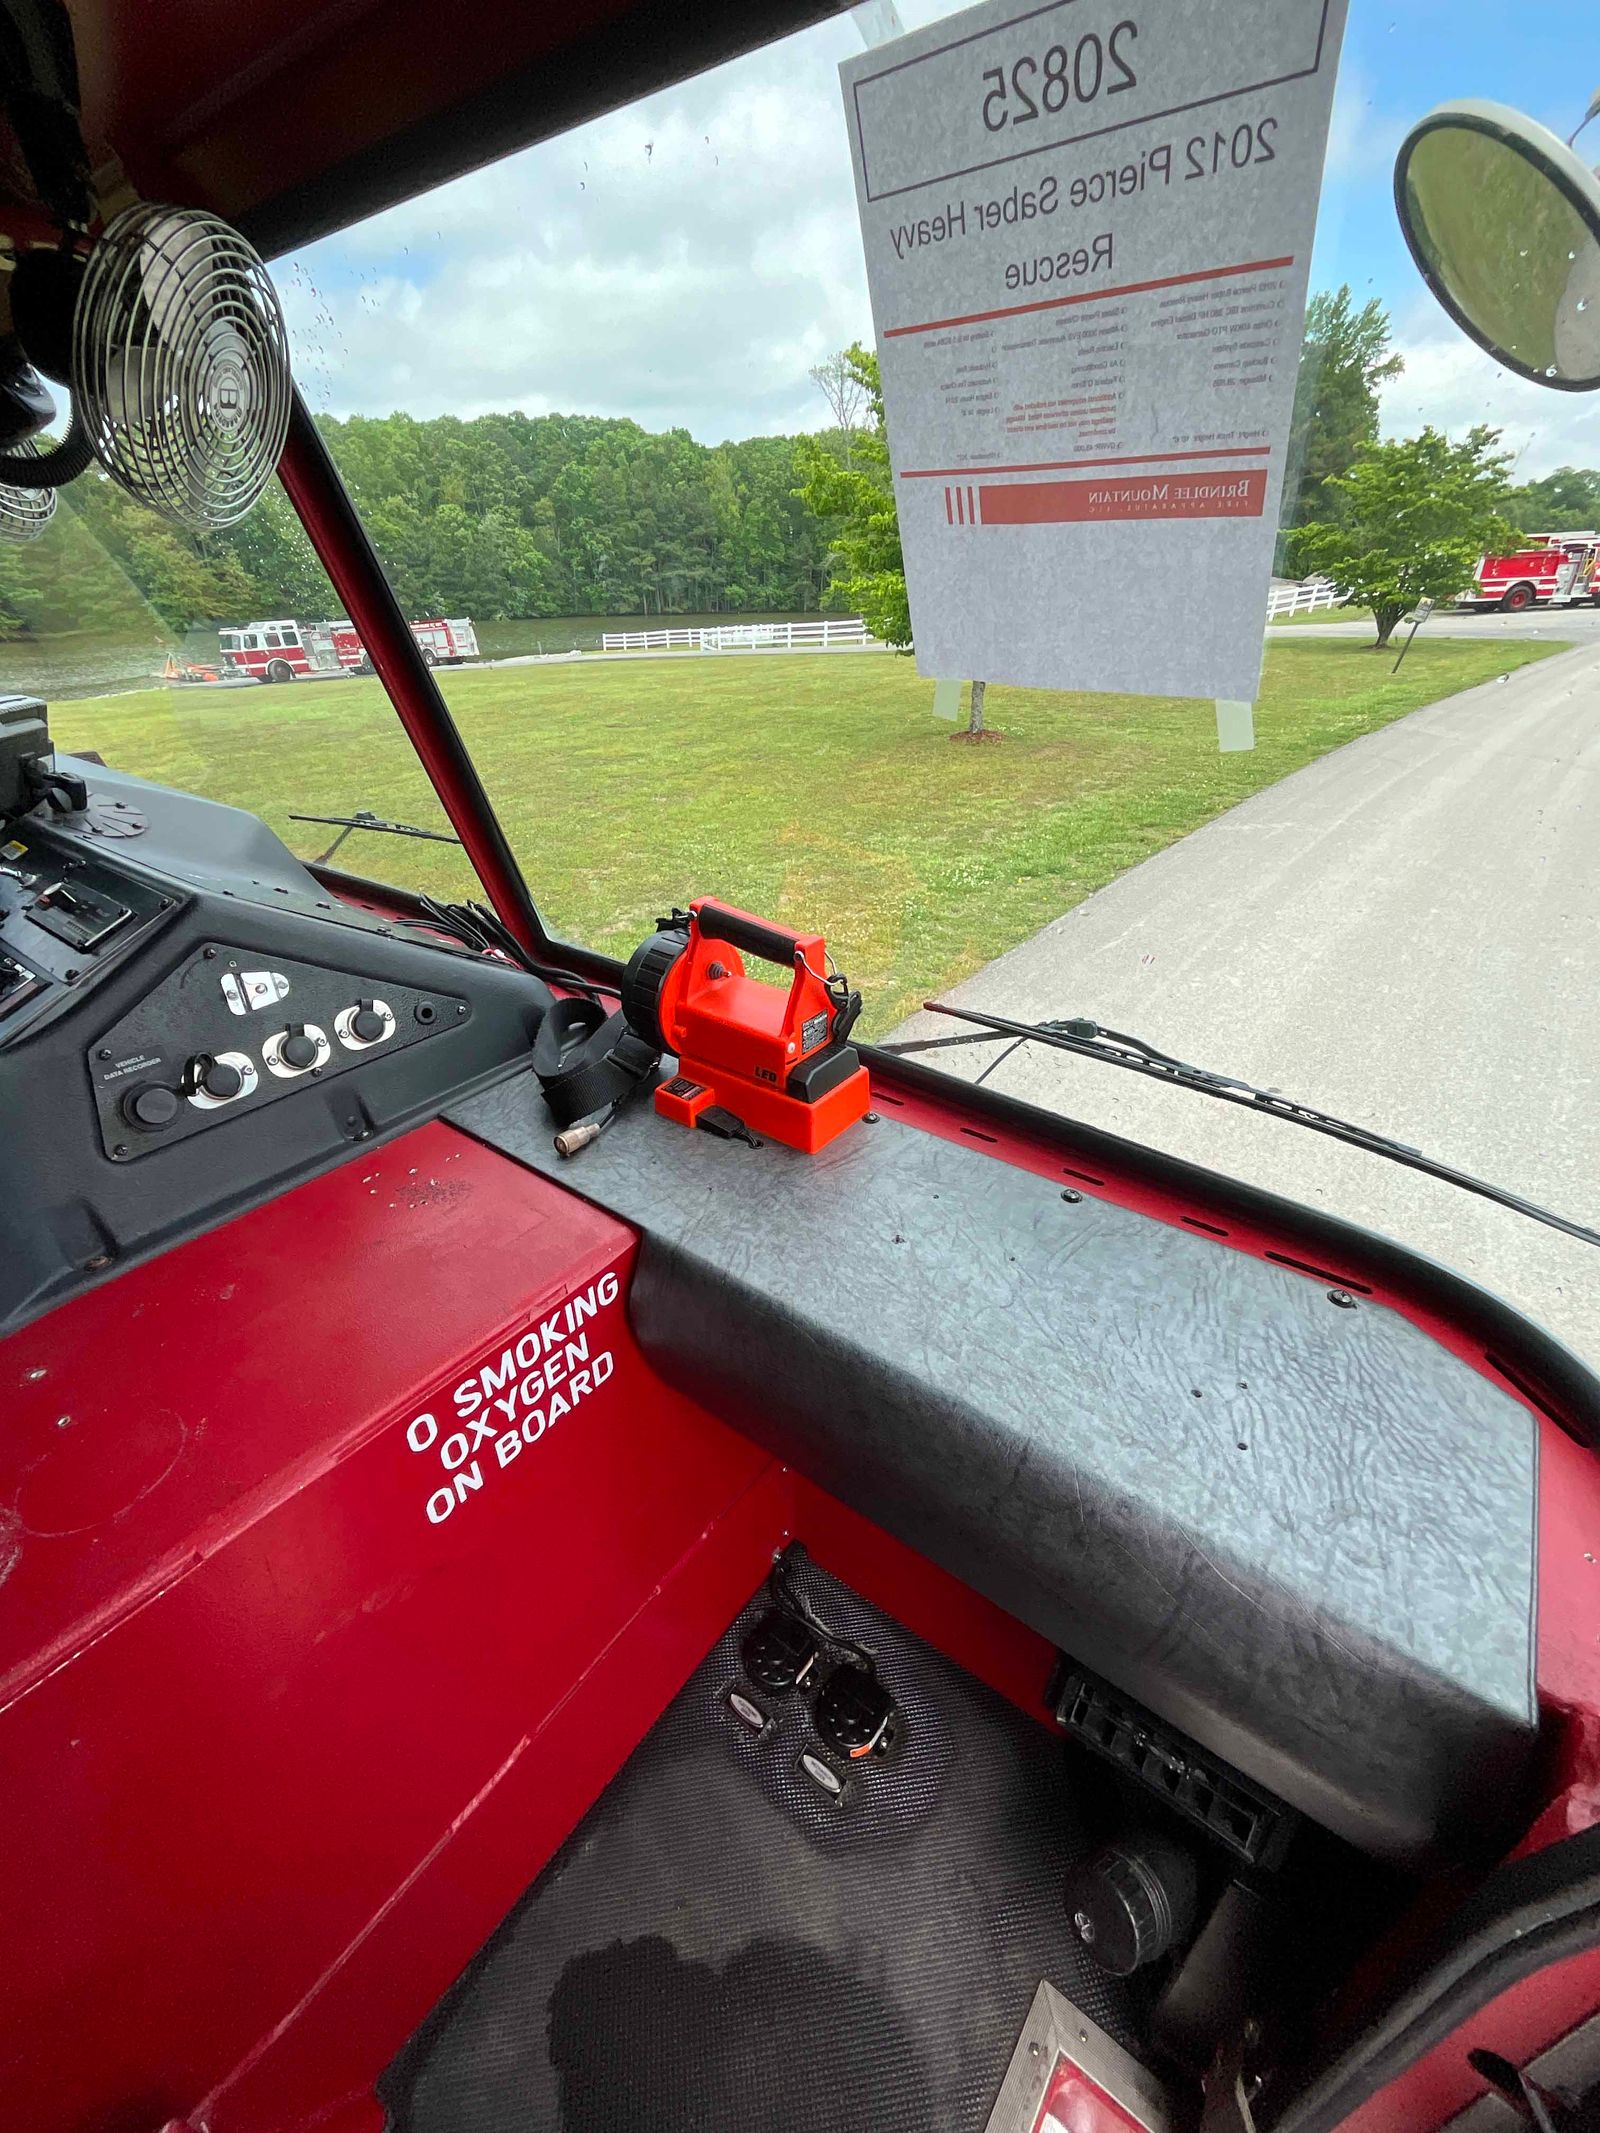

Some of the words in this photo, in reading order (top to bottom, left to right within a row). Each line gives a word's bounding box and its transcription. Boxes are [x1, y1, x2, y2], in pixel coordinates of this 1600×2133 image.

[104, 1070, 123, 1080] DATA
[123, 1057, 161, 1074] RECORDER
[115, 1054, 145, 1068] VEHICLE
[754, 1066, 777, 1083] LED
[453, 1271, 619, 1418] SMOKING
[425, 1460, 484, 1524] ON
[494, 1351, 614, 1469] BOARD
[440, 1331, 590, 1470] OXYGEN
